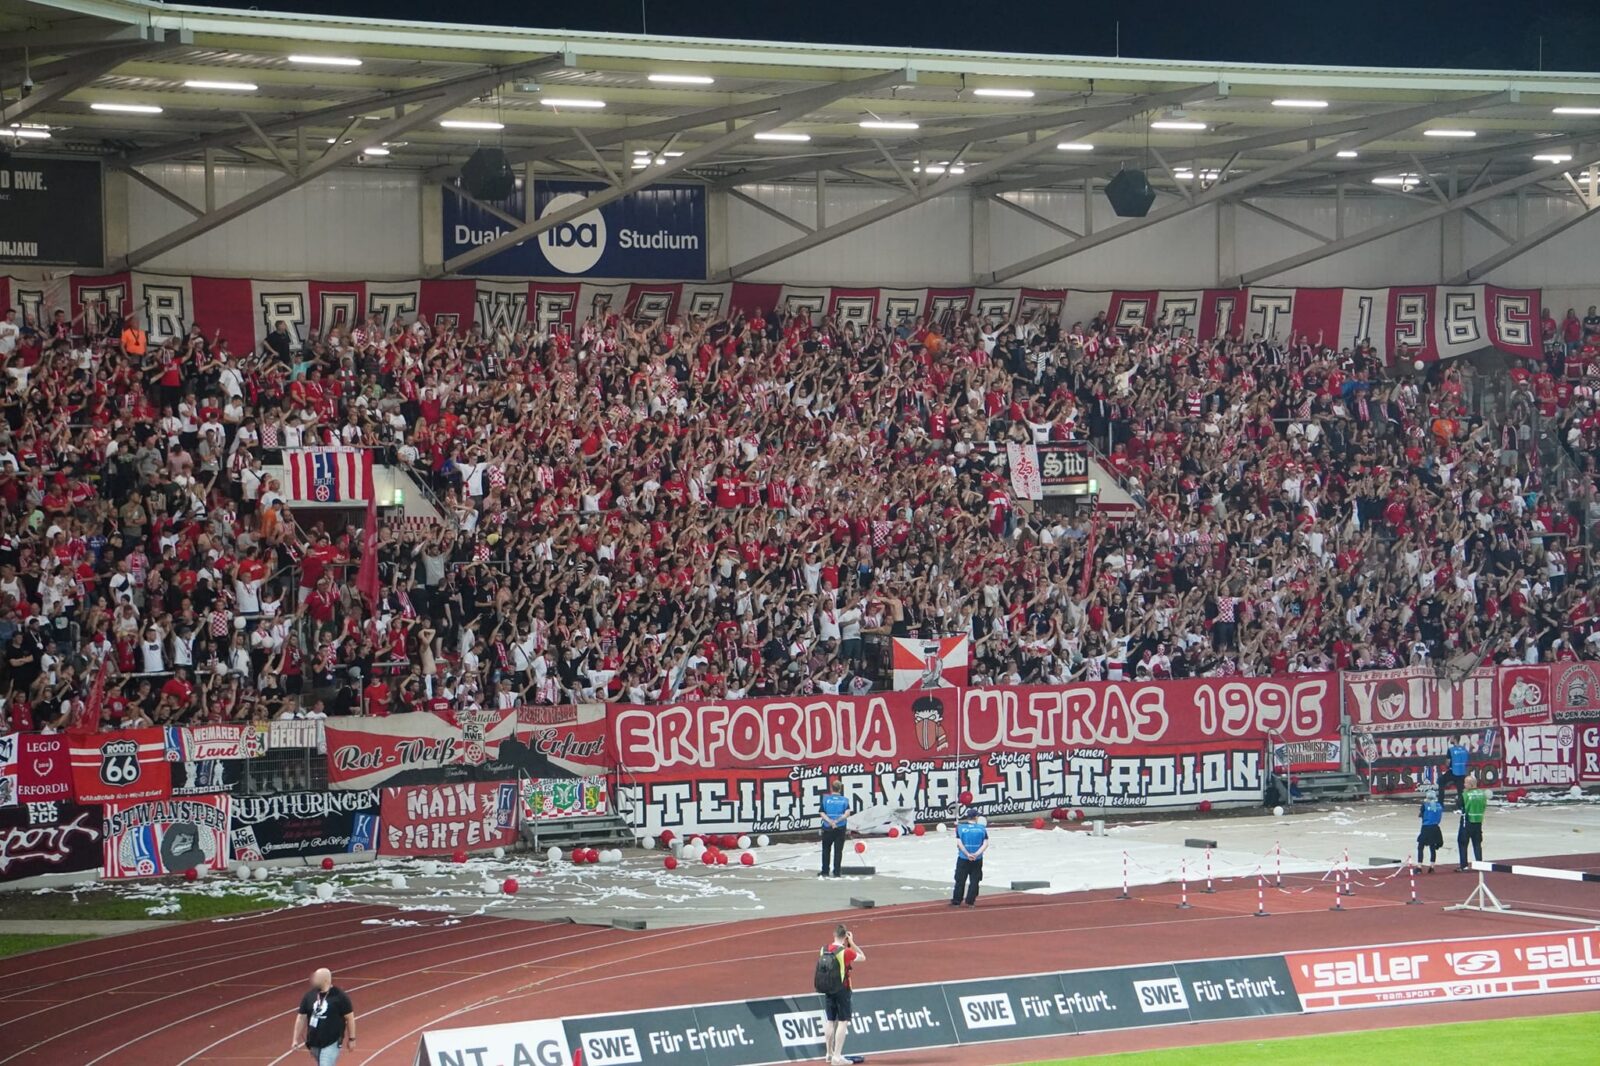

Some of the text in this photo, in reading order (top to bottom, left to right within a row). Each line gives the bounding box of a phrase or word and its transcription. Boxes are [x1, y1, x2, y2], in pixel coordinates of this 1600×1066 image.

[14, 171, 47, 190] RWE.
[0, 241, 38, 256] NJAKU
[619, 229, 699, 249] Studium
[1354, 292, 1532, 347] 1966
[1043, 453, 1086, 477] Süd
[193, 727, 240, 742] WEIMARER
[271, 729, 316, 747] BERLIN
[466, 725, 478, 733] FC
[616, 680, 1327, 773] ERFORDIA ULTRAS 1996
[26, 741, 60, 753] LEGIO
[106, 743, 136, 755] ROOTS
[196, 745, 239, 759] Land
[335, 745, 382, 771] Rot
[395, 737, 456, 764] Weiß
[535, 728, 605, 758] Erfurt
[1381, 738, 1413, 757] LOS
[1502, 724, 1574, 763] WEST
[106, 755, 138, 782] 66
[789, 765, 822, 781] Einst
[829, 763, 864, 775] warst
[896, 759, 935, 775] Zeuge
[942, 758, 979, 770] unserer
[988, 752, 1030, 769] Erfolge
[617, 750, 1262, 828] STEIGERWALDSTADION
[27, 801, 57, 812] FCK
[407, 783, 476, 820] MAIN
[753, 816, 780, 831] nach
[788, 816, 811, 829] dem
[917, 807, 946, 820] alten
[989, 797, 1025, 813] werden
[1032, 799, 1050, 809] wir
[1081, 793, 1105, 806] ewig
[1113, 793, 1146, 806] sehnen
[29, 812, 58, 824] FCC
[233, 836, 255, 848] RWE
[234, 828, 248, 839] FC
[388, 816, 503, 849] FIGHTER
[1141, 985, 1182, 1006] SWE
[1192, 976, 1286, 1002] Für Erfurt.
[967, 1000, 1009, 1022] SWE
[1021, 991, 1117, 1018] Für Erfurt.
[781, 1015, 825, 1040] SWE
[847, 1006, 940, 1035] ür Erfurt.
[588, 1036, 633, 1060] SWE
[649, 1023, 754, 1055] Für Erfurt.
